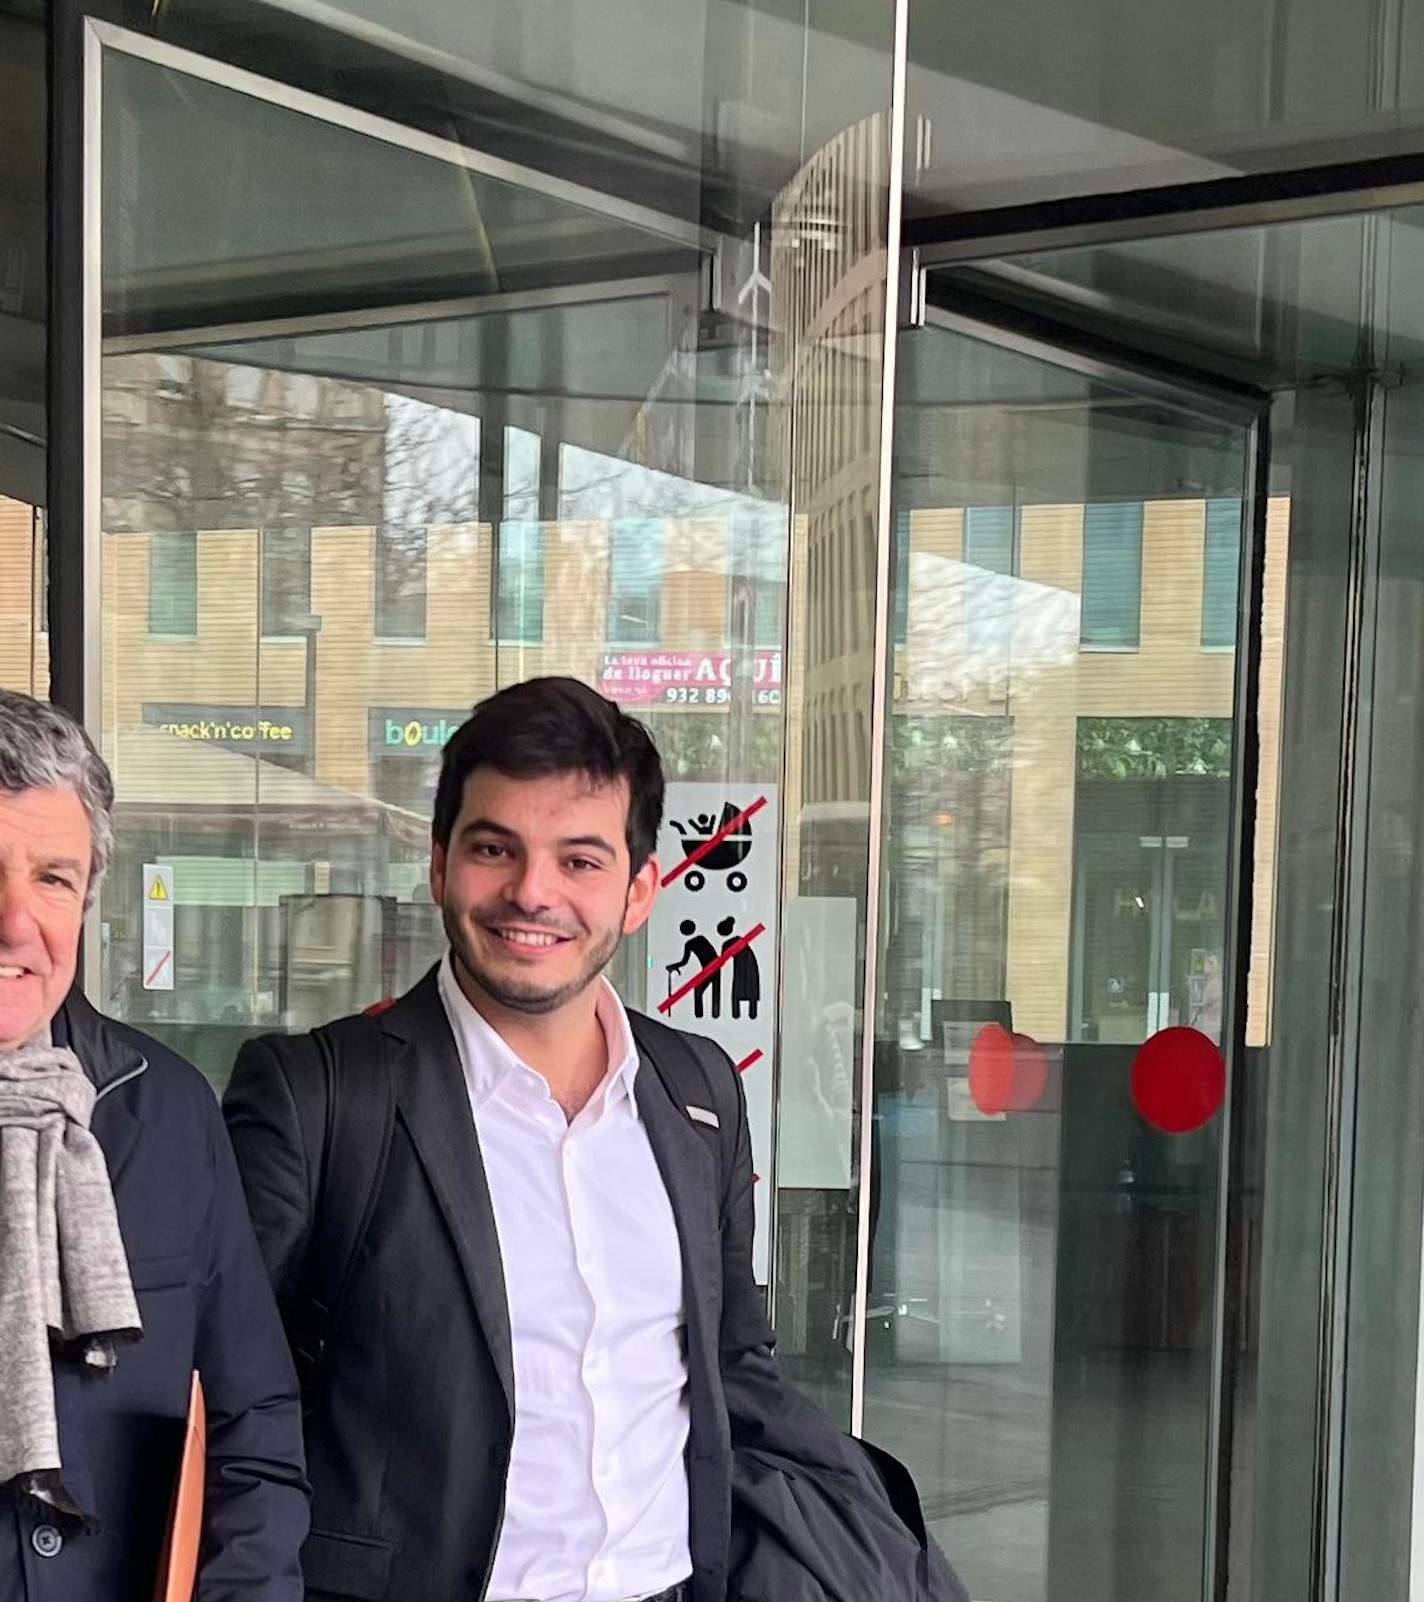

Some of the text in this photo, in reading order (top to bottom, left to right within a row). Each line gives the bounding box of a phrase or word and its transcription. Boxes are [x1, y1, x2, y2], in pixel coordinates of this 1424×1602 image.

[603, 667, 623, 681] de
[666, 687, 699, 704] 932
[705, 688, 732, 704] 89
